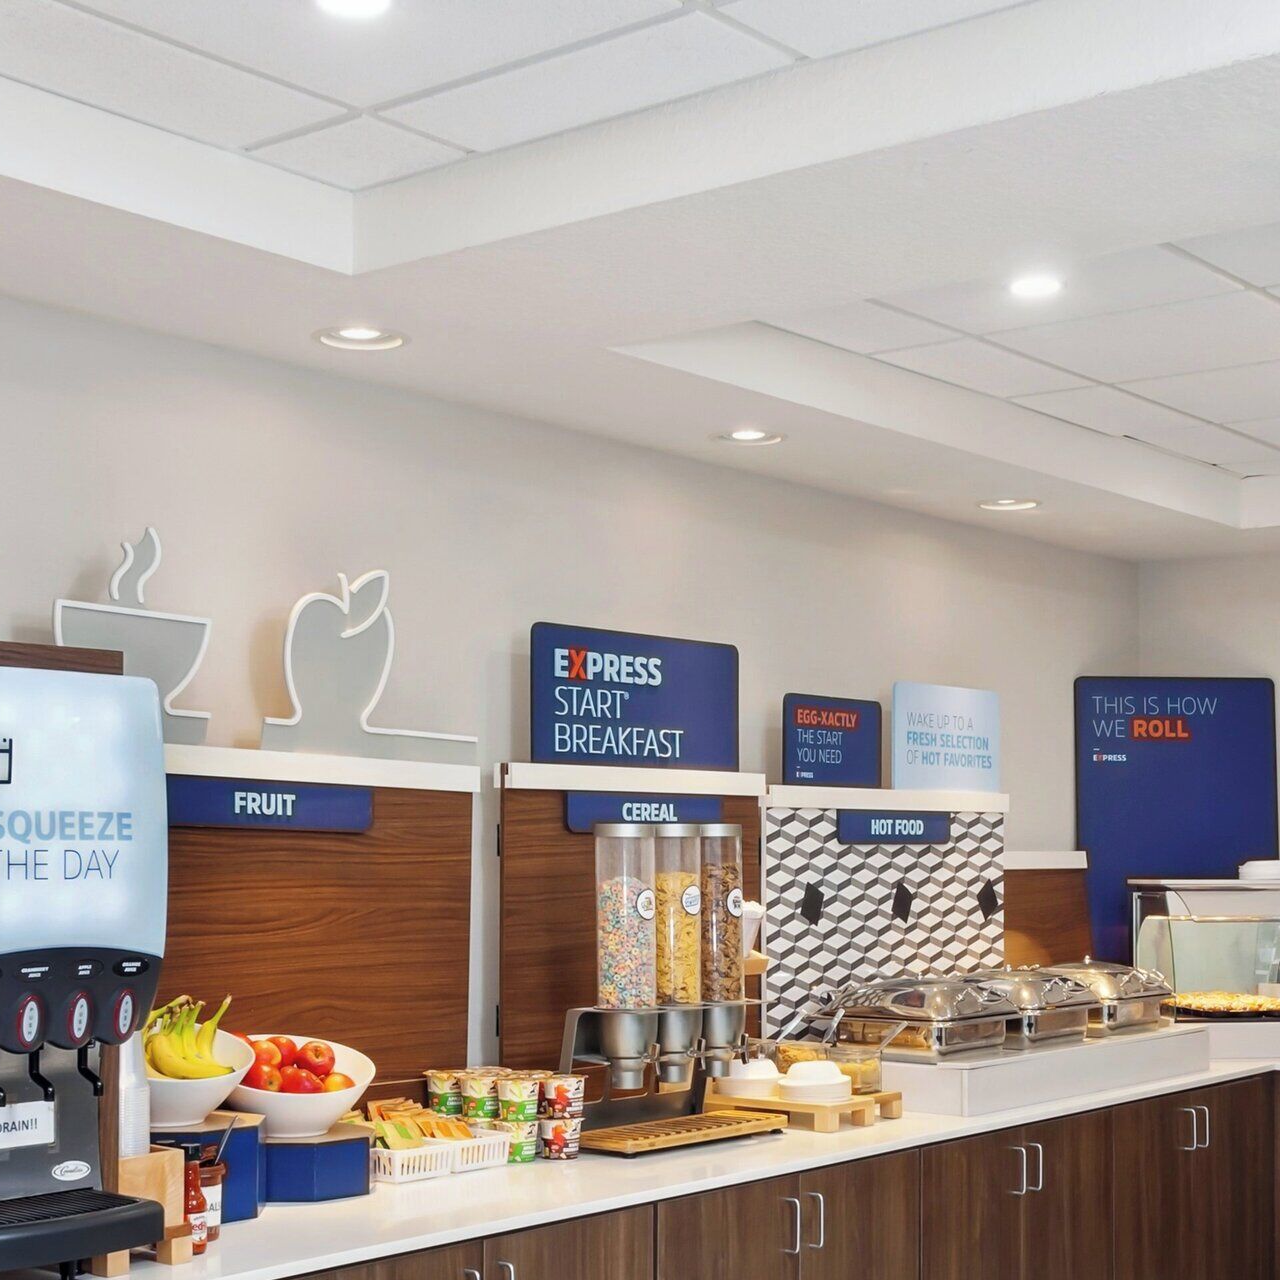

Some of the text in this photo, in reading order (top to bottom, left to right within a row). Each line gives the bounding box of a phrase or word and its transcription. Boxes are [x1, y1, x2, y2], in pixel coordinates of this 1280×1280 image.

[553, 647, 663, 687] EXPRESS
[1091, 695, 1218, 716] THIS IS HOW
[796, 708, 858, 728] EGG-XACTLY
[906, 711, 974, 732] WAKE UP TO A
[796, 728, 844, 747] THE START
[1092, 719, 1189, 738] WE ROLL
[553, 722, 685, 759] BREAKFAST
[906, 731, 989, 751] FRESH SELECTION
[796, 747, 843, 764] YOU NEED
[906, 749, 992, 769] OF HOT FAVORITES
[1092, 753, 1127, 762] EXPRESS
[233, 790, 296, 817] FRUIT
[621, 802, 678, 822] CEREAL
[870, 818, 924, 836] HOT FOOD
[63, 849, 120, 881] DAY
